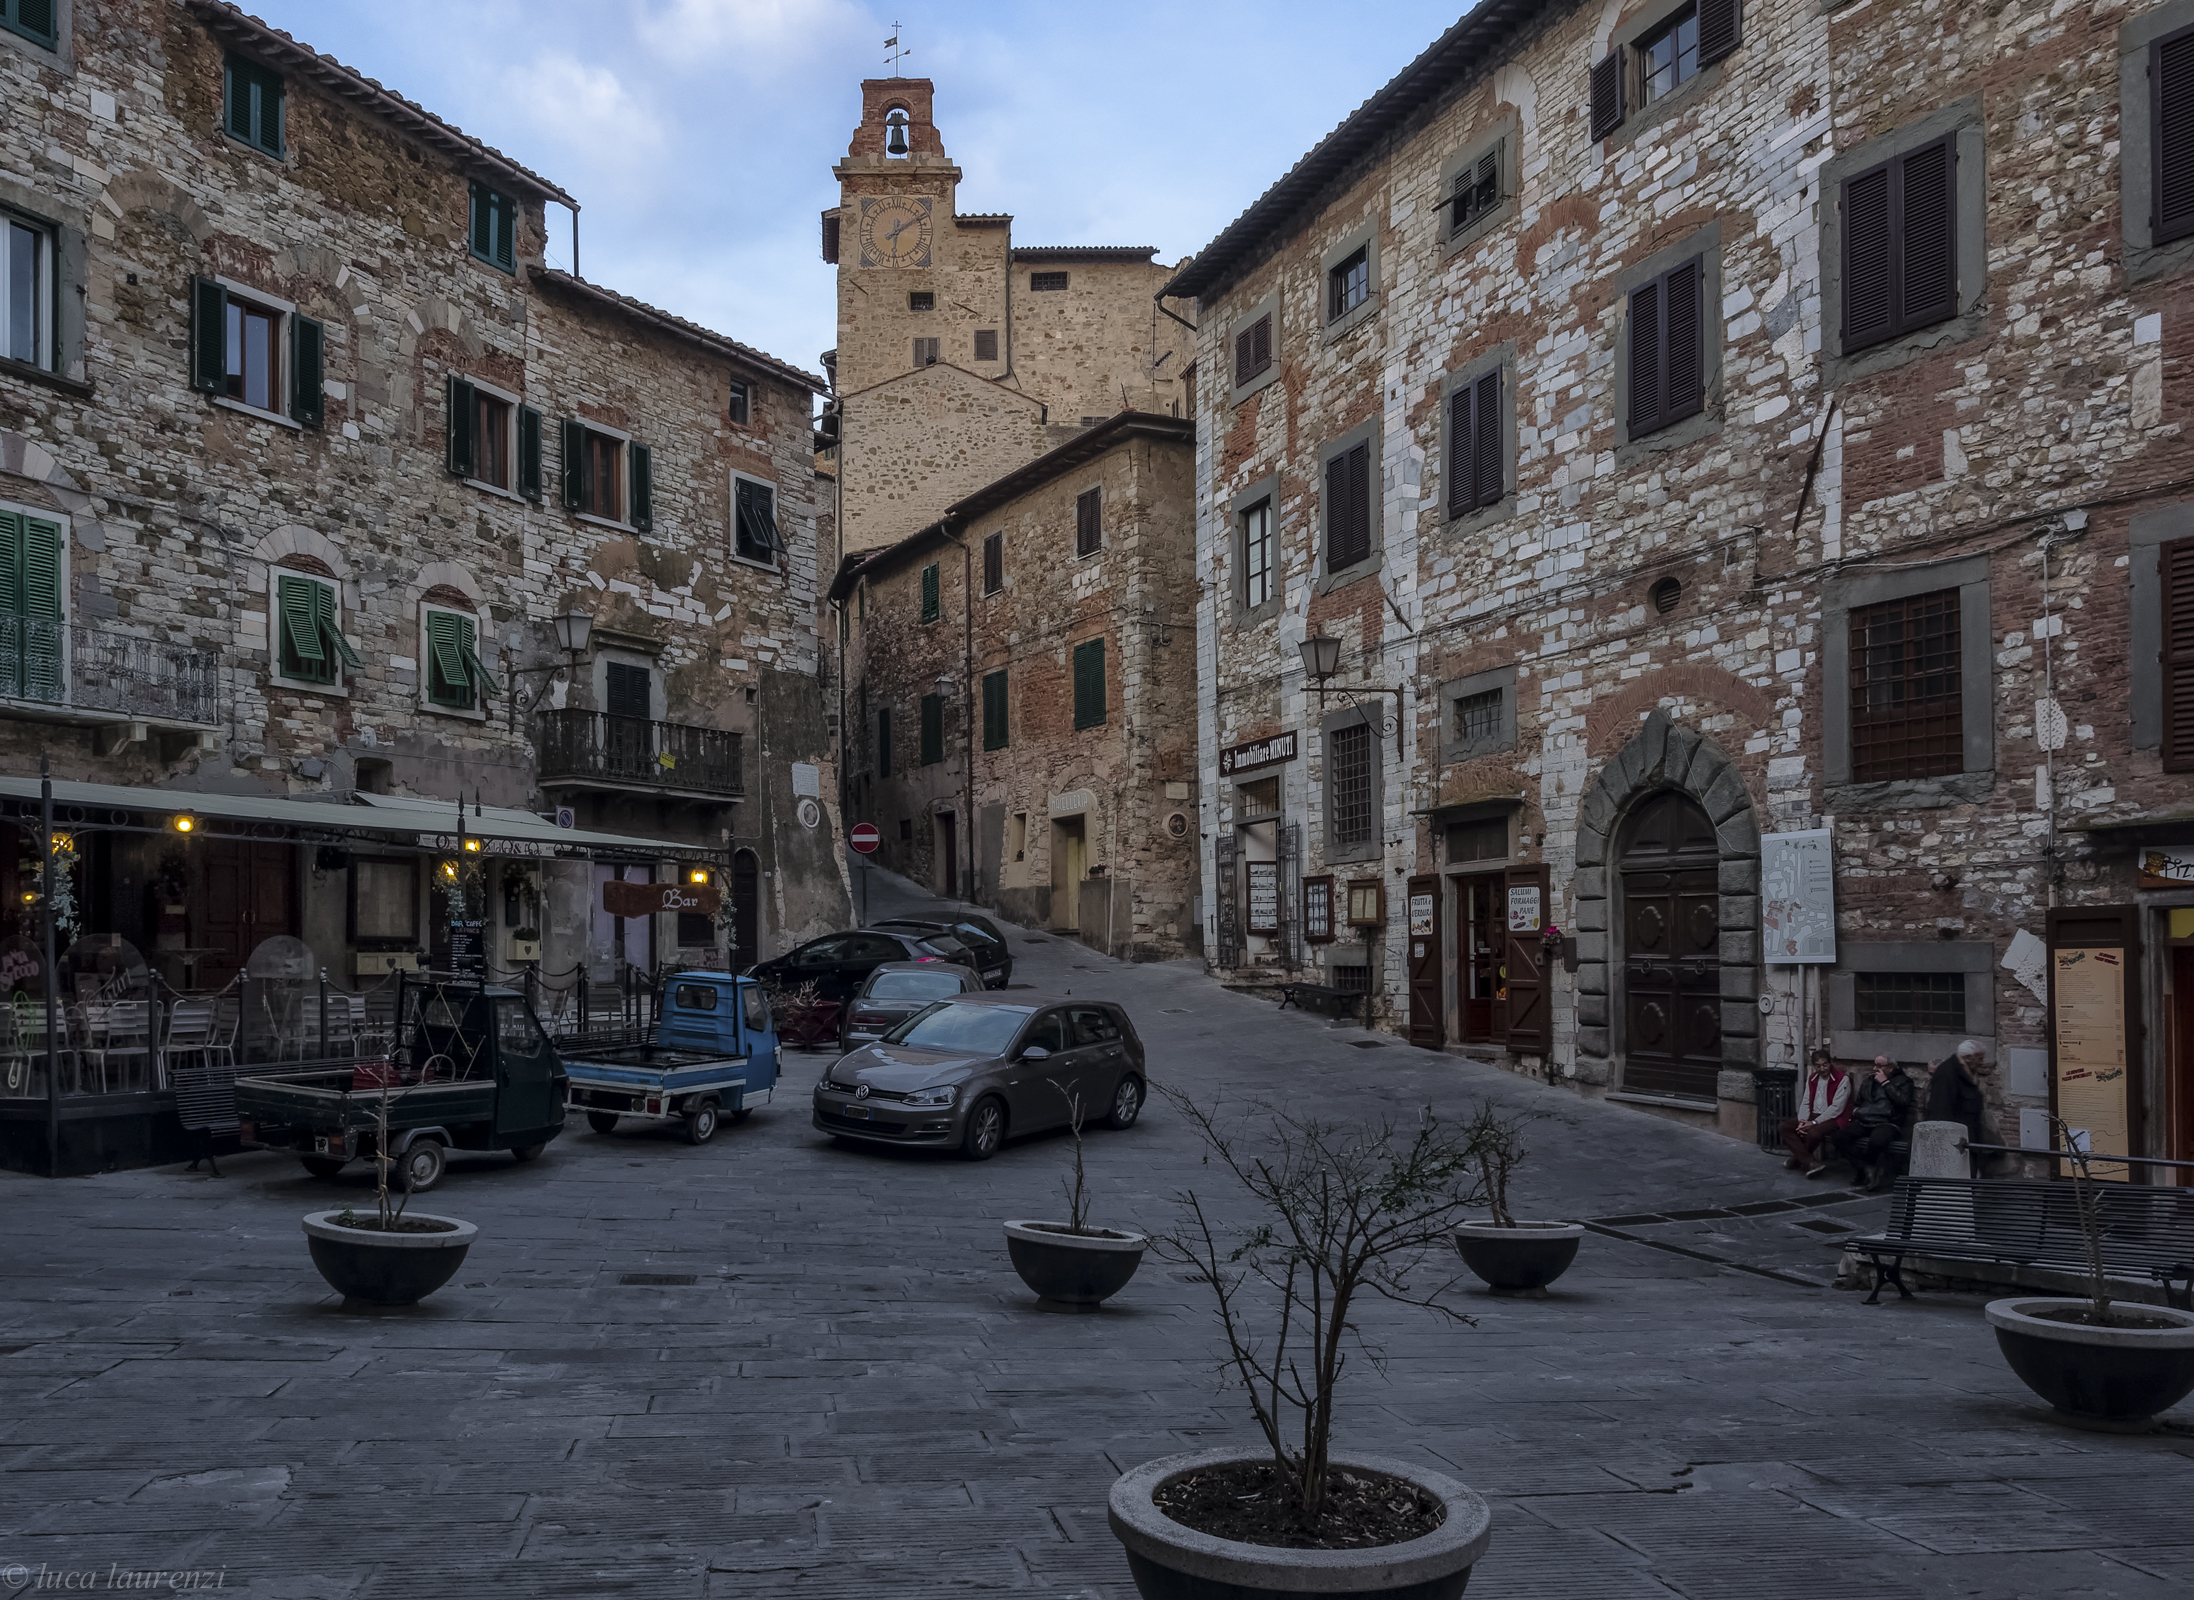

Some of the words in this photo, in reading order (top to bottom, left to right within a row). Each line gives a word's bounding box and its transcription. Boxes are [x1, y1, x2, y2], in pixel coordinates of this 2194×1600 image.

[1234, 744, 1269, 768] Immobiliare
[1269, 735, 1293, 760] MINUTI
[1051, 792, 1088, 813] MACELLERIA
[1510, 888, 1531, 896] SALUMI
[662, 888, 698, 909] Bar
[1411, 898, 1428, 906] FRUTTA
[1511, 897, 1539, 905] FORMAGGI
[1411, 909, 1432, 917] VERDURA
[1519, 906, 1535, 914] PANE
